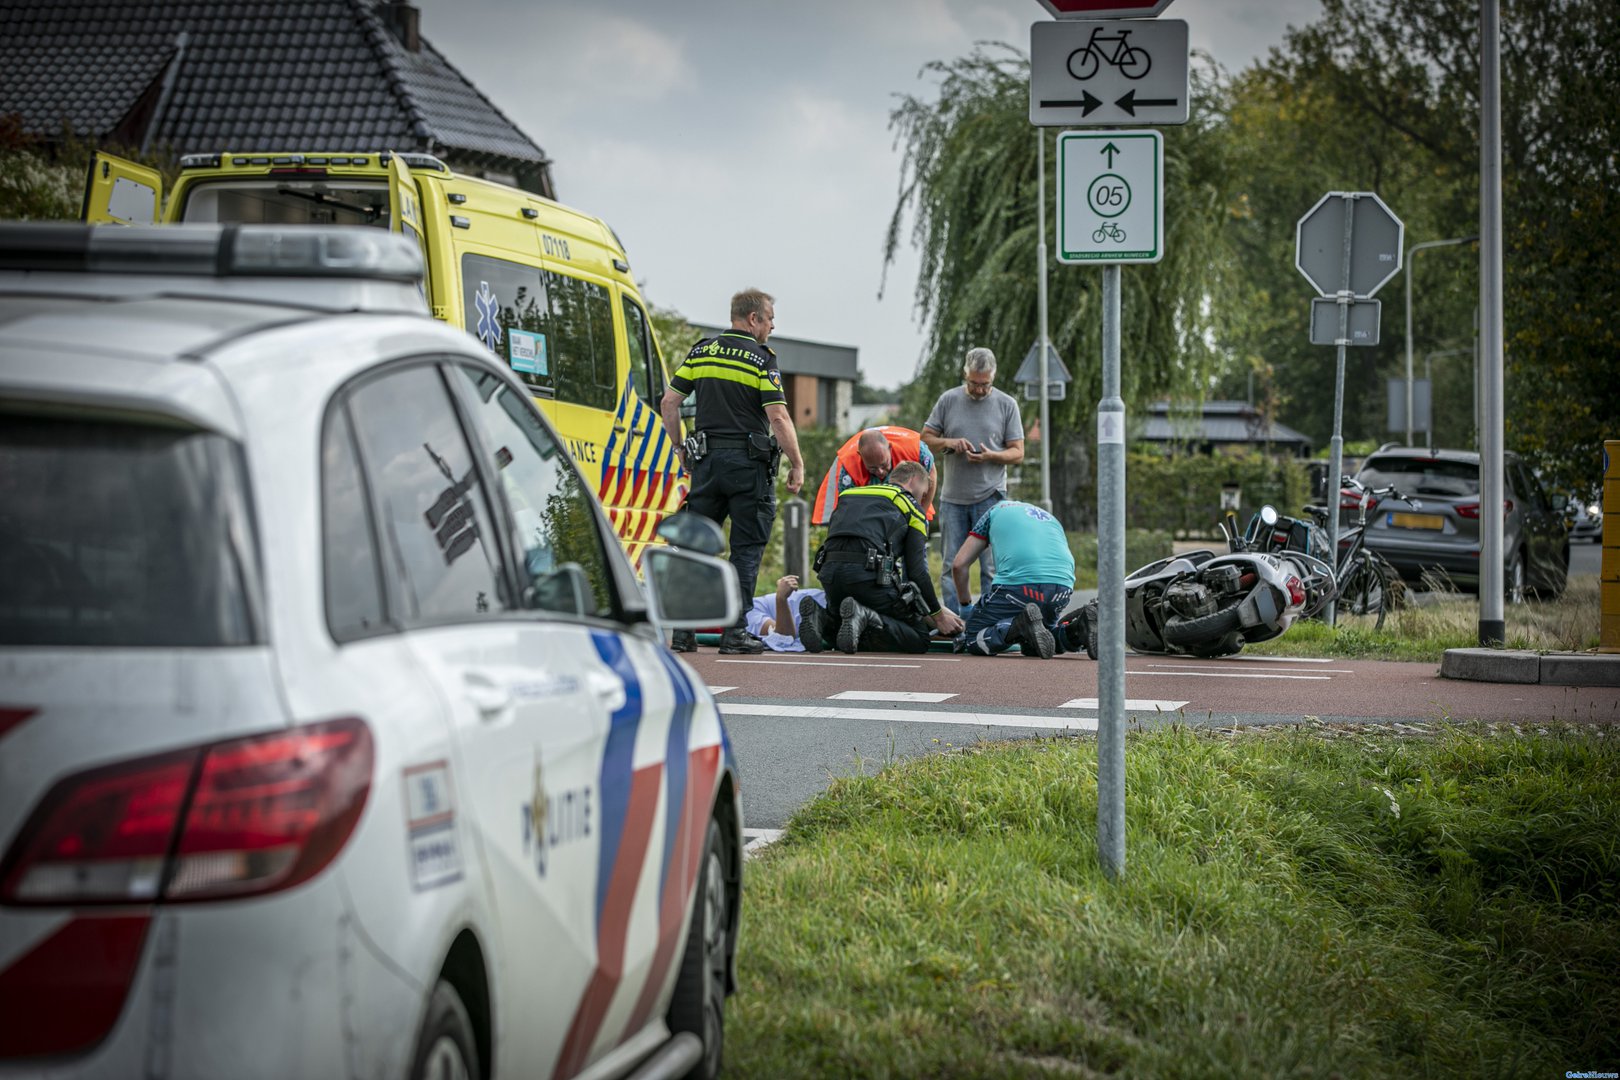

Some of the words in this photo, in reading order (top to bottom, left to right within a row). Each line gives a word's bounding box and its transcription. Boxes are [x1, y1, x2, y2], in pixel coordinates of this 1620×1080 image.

[1096, 185, 1124, 206] 05
[543, 234, 571, 261] 07118
[702, 341, 751, 359] POLITIE
